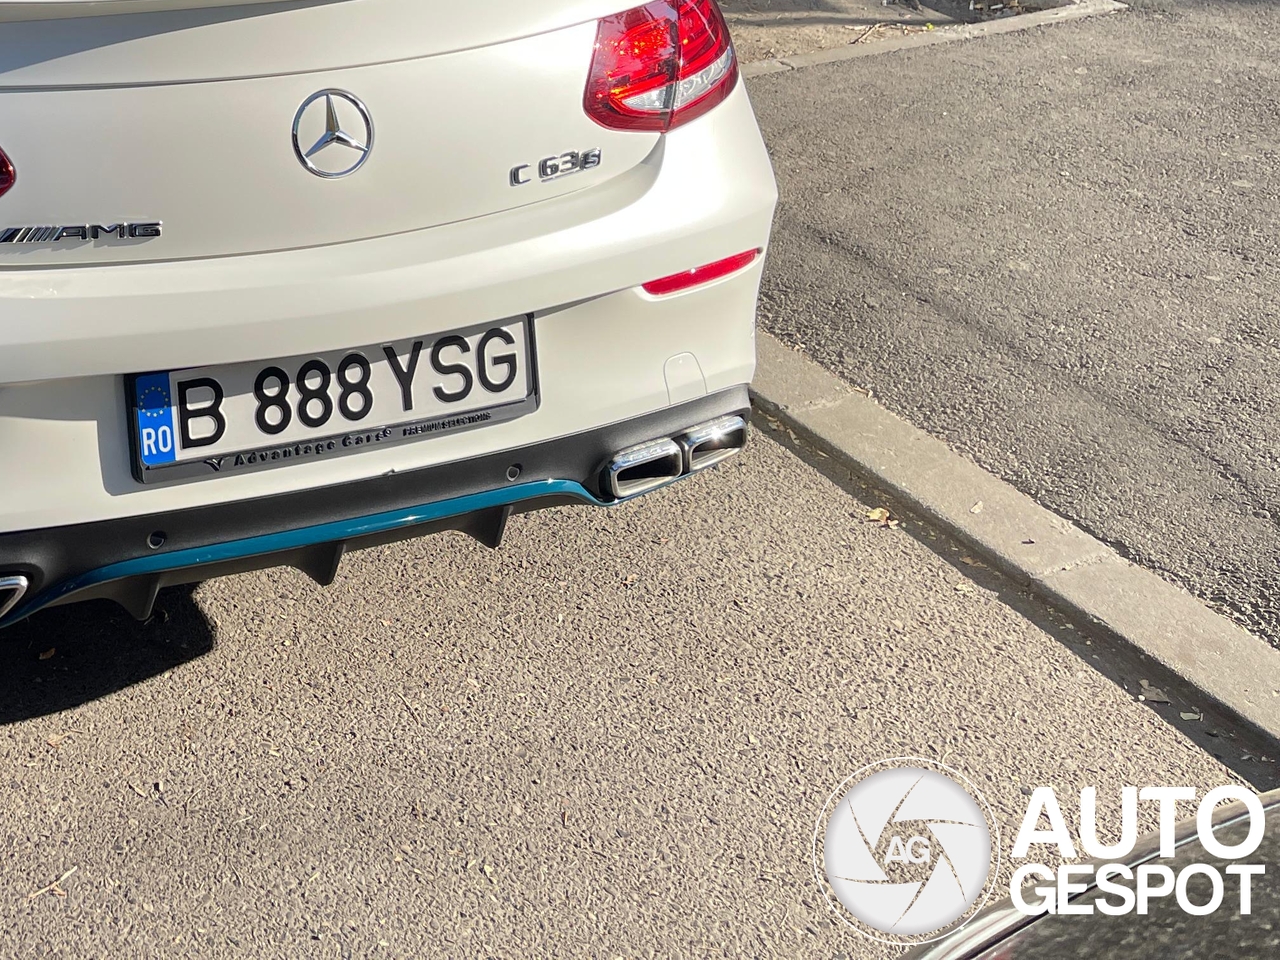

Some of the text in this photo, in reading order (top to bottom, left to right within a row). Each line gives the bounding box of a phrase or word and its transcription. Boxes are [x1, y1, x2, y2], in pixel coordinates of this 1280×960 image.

[509, 163, 531, 186] C
[177, 327, 517, 449] B 888 YSG
[142, 425, 172, 456] RO
[234, 440, 336, 467] Advantage
